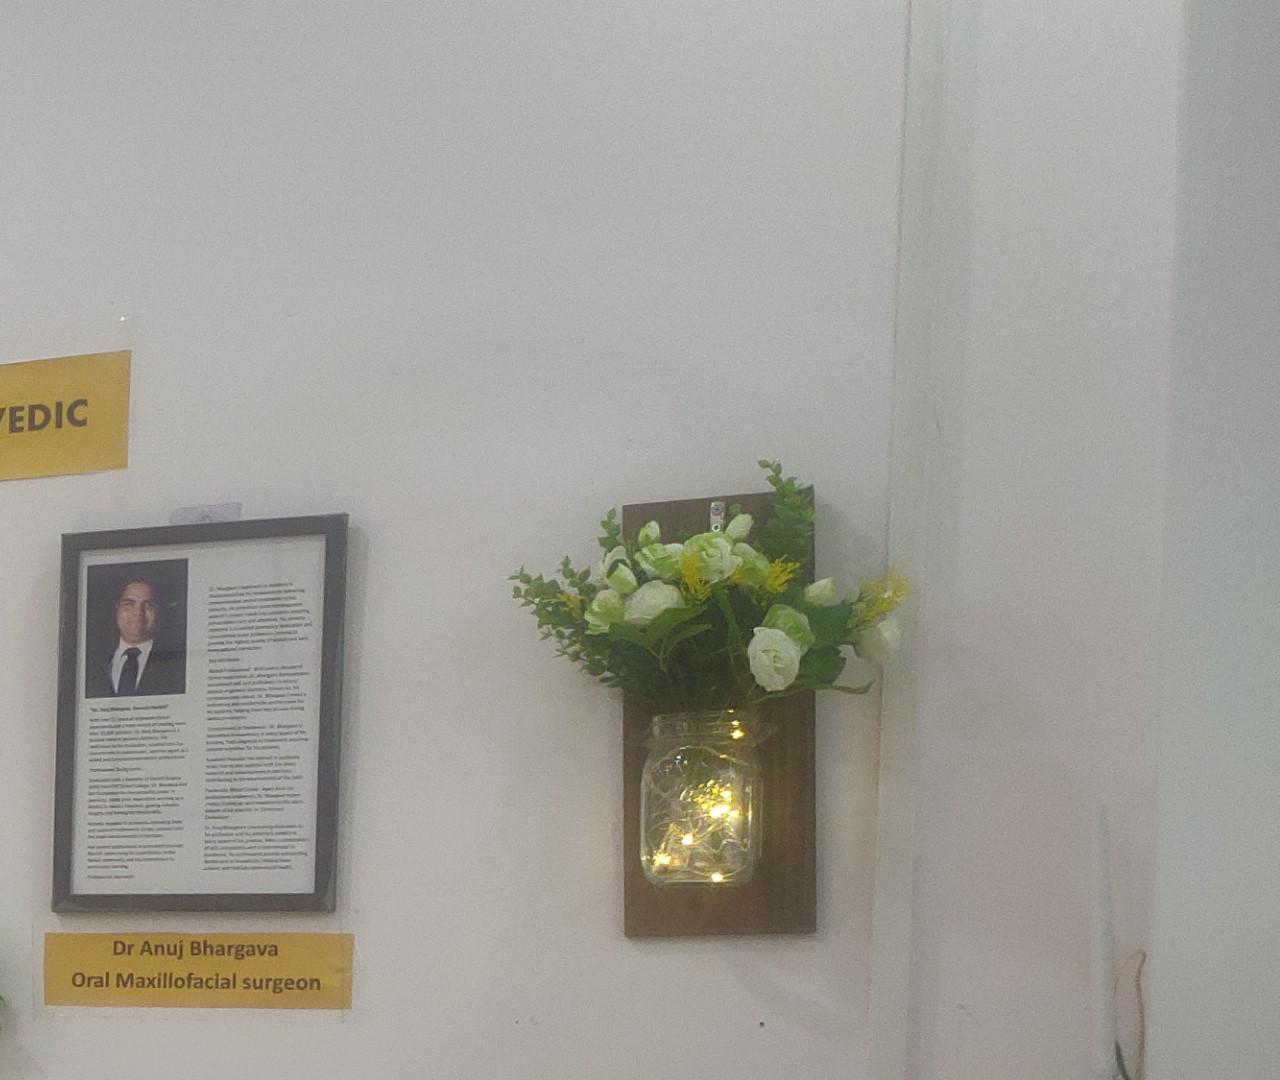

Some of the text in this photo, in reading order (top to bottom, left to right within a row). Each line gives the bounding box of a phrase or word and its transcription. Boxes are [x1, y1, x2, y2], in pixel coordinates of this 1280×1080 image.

[112, 940, 279, 960] Dr Anuj Bhargava
[71, 971, 321, 994] Oral Maxillofacial surgeon
